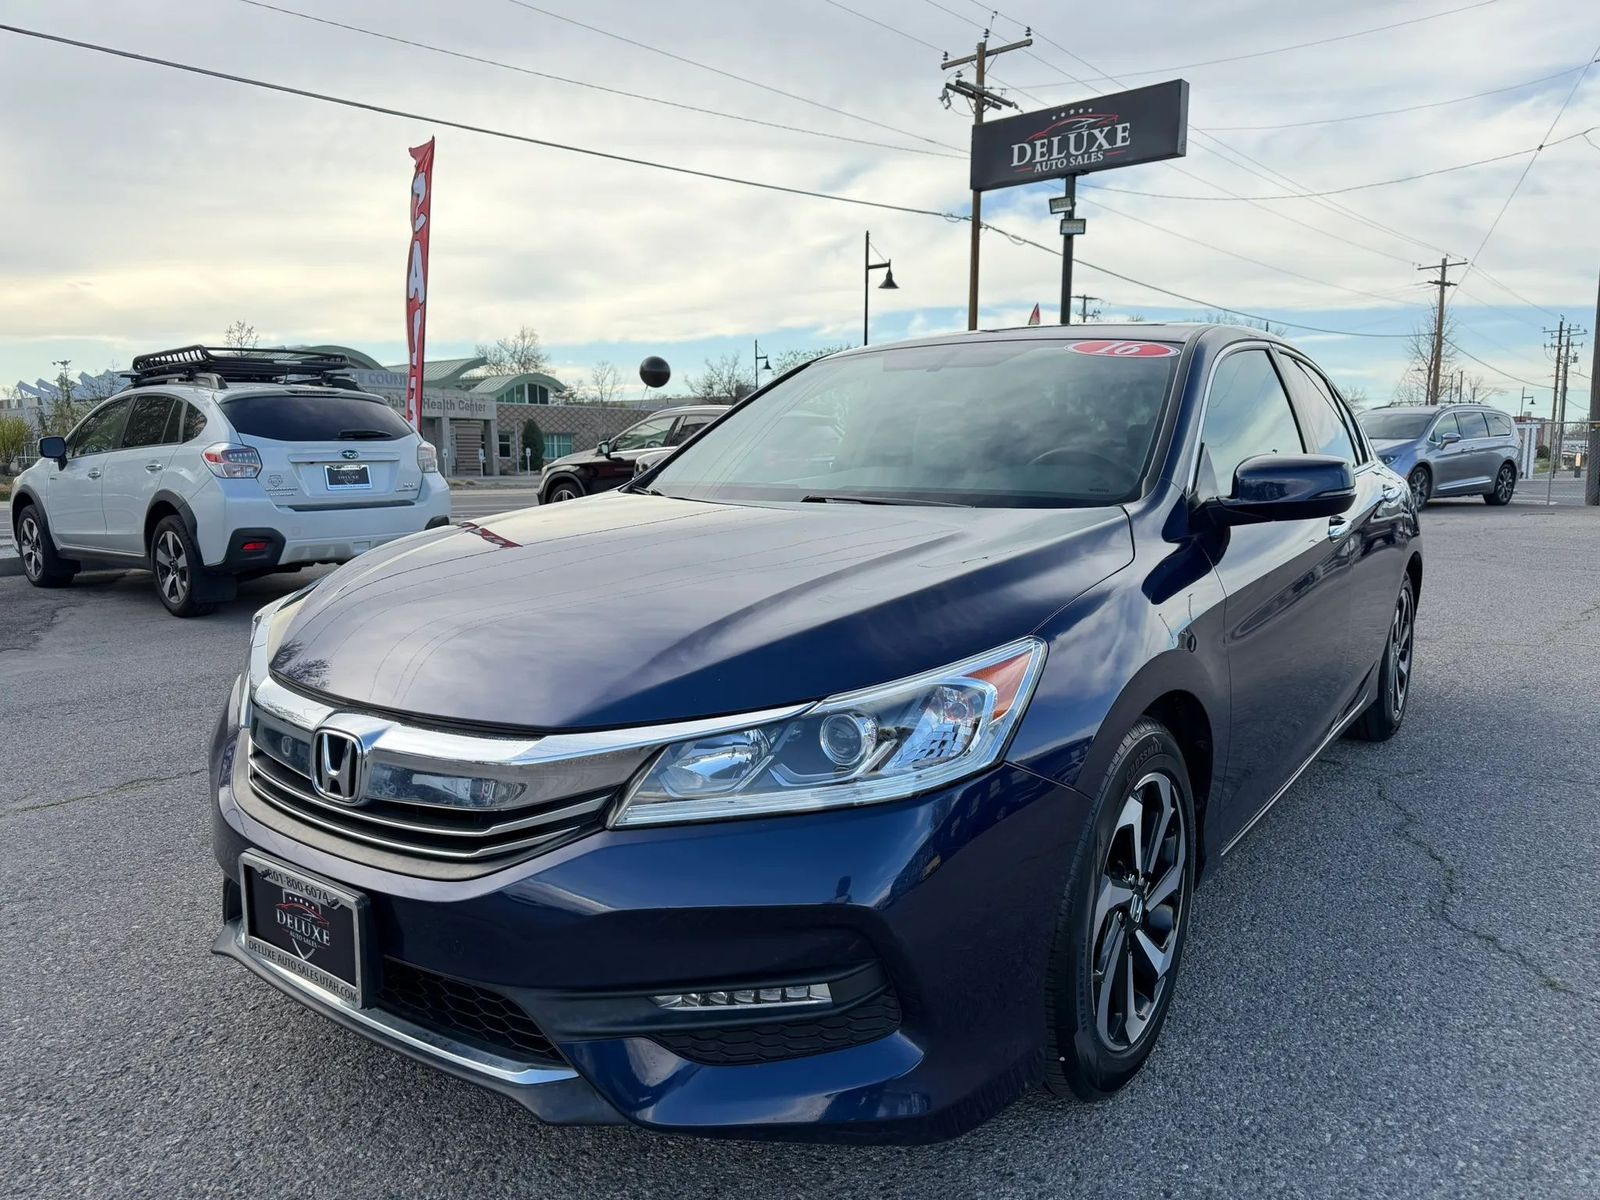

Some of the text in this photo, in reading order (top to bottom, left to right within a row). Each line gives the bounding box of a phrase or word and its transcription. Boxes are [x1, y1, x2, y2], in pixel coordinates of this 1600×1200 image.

[1010, 122, 1131, 167] DELUXE
[1034, 151, 1104, 173] AUTO SALES
[423, 398, 455, 411] Health
[459, 401, 487, 413] Center
[276, 908, 331, 946] DELUXE
[289, 930, 302, 943] AUTO
[248, 940, 358, 1003] DELUXE AUTO SALES UTAH.COM
